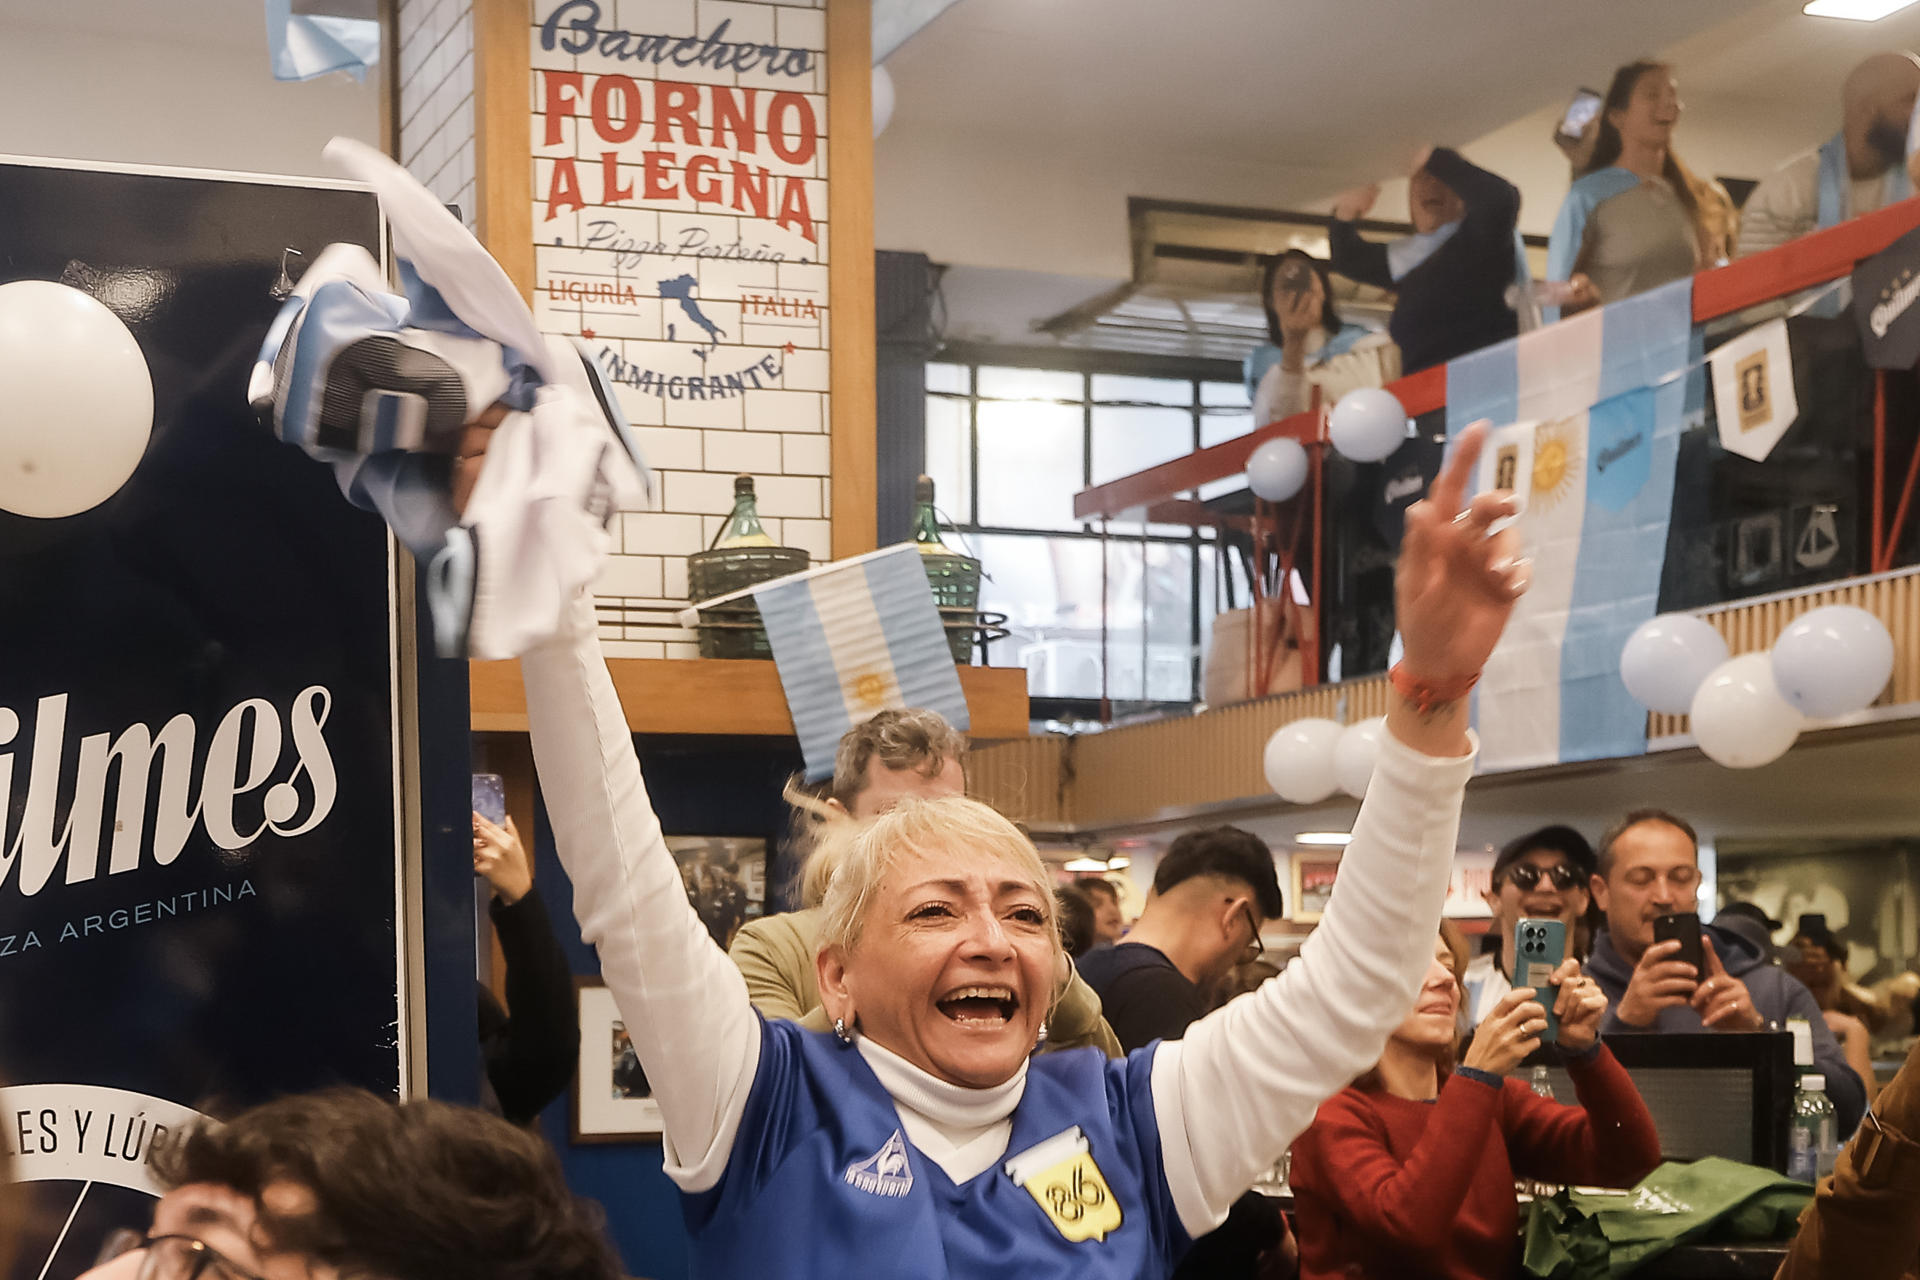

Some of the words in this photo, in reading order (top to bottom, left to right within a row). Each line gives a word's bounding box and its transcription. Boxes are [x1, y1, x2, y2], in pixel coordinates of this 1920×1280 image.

[540, 0, 816, 79] Banchero
[543, 70, 817, 166] FORNO
[544, 150, 818, 245] ALEGNA
[580, 220, 666, 270] Pizza
[548, 279, 637, 307] LIGURIA
[740, 293, 818, 321] ITALIA
[599, 345, 784, 402] INMIGRANTE
[59, 879, 257, 944] ARGENTINA
[74, 1109, 93, 1153] Y
